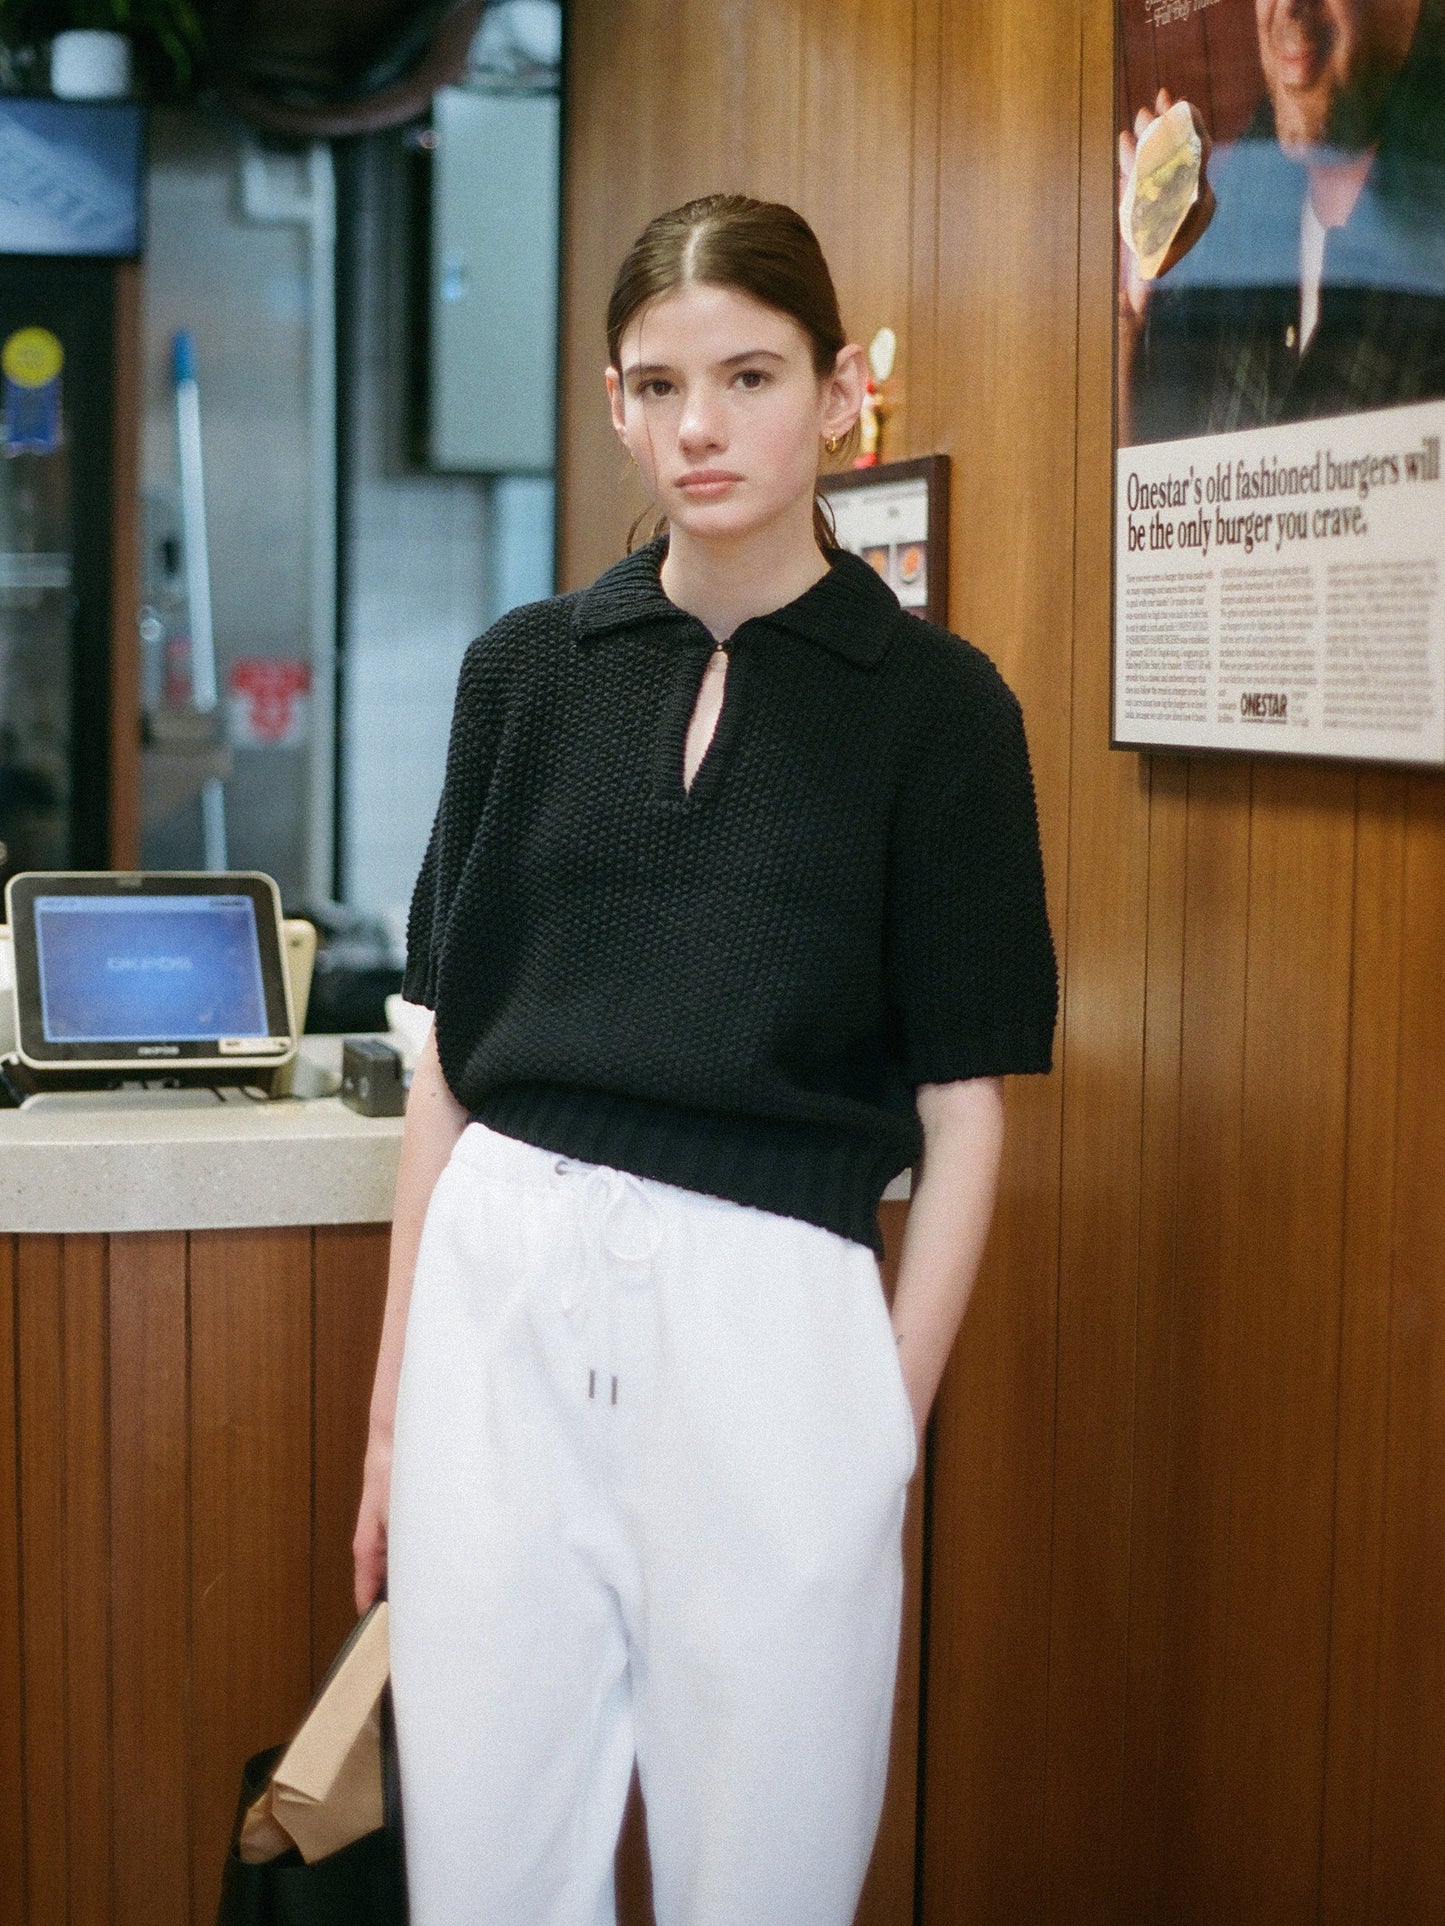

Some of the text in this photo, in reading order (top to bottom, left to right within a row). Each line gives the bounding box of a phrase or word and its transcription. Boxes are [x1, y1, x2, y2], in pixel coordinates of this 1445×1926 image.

[1127, 465, 1202, 511] Onestar's
[1206, 460, 1231, 504] old
[1236, 450, 1320, 500] fashioned
[1326, 450, 1399, 499] burgers
[1128, 505, 1368, 557] be the only burger you crave.
[1240, 692, 1287, 718] ONESTAR
